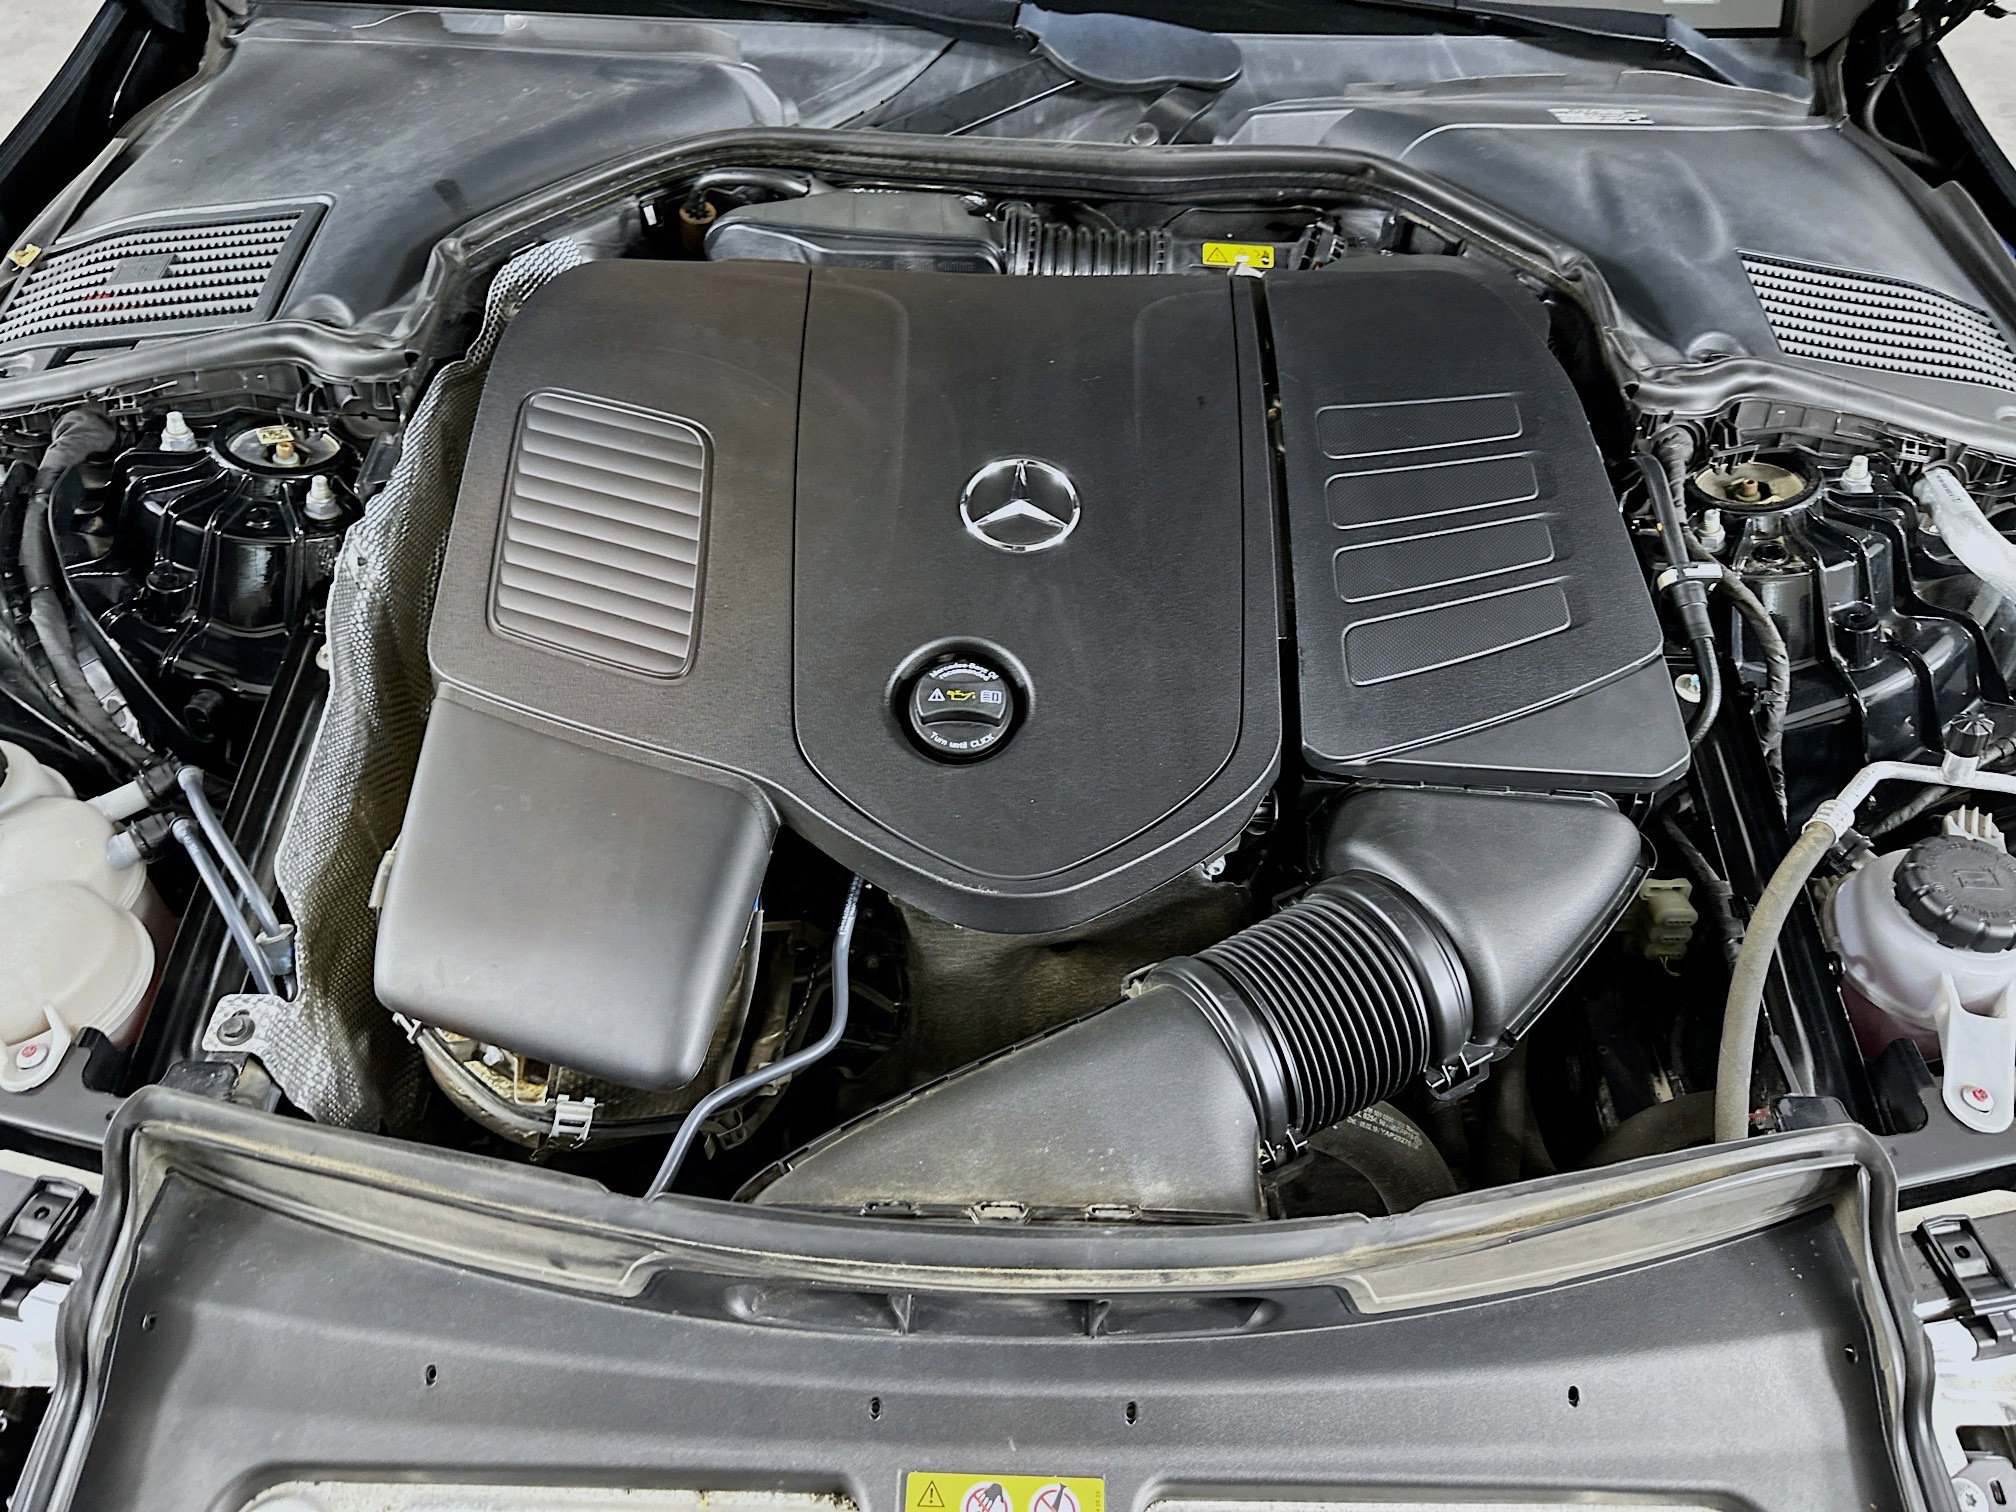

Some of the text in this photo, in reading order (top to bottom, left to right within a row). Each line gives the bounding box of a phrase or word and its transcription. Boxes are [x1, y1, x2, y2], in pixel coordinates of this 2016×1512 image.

[930, 731, 995, 749] Turn until CLICK
